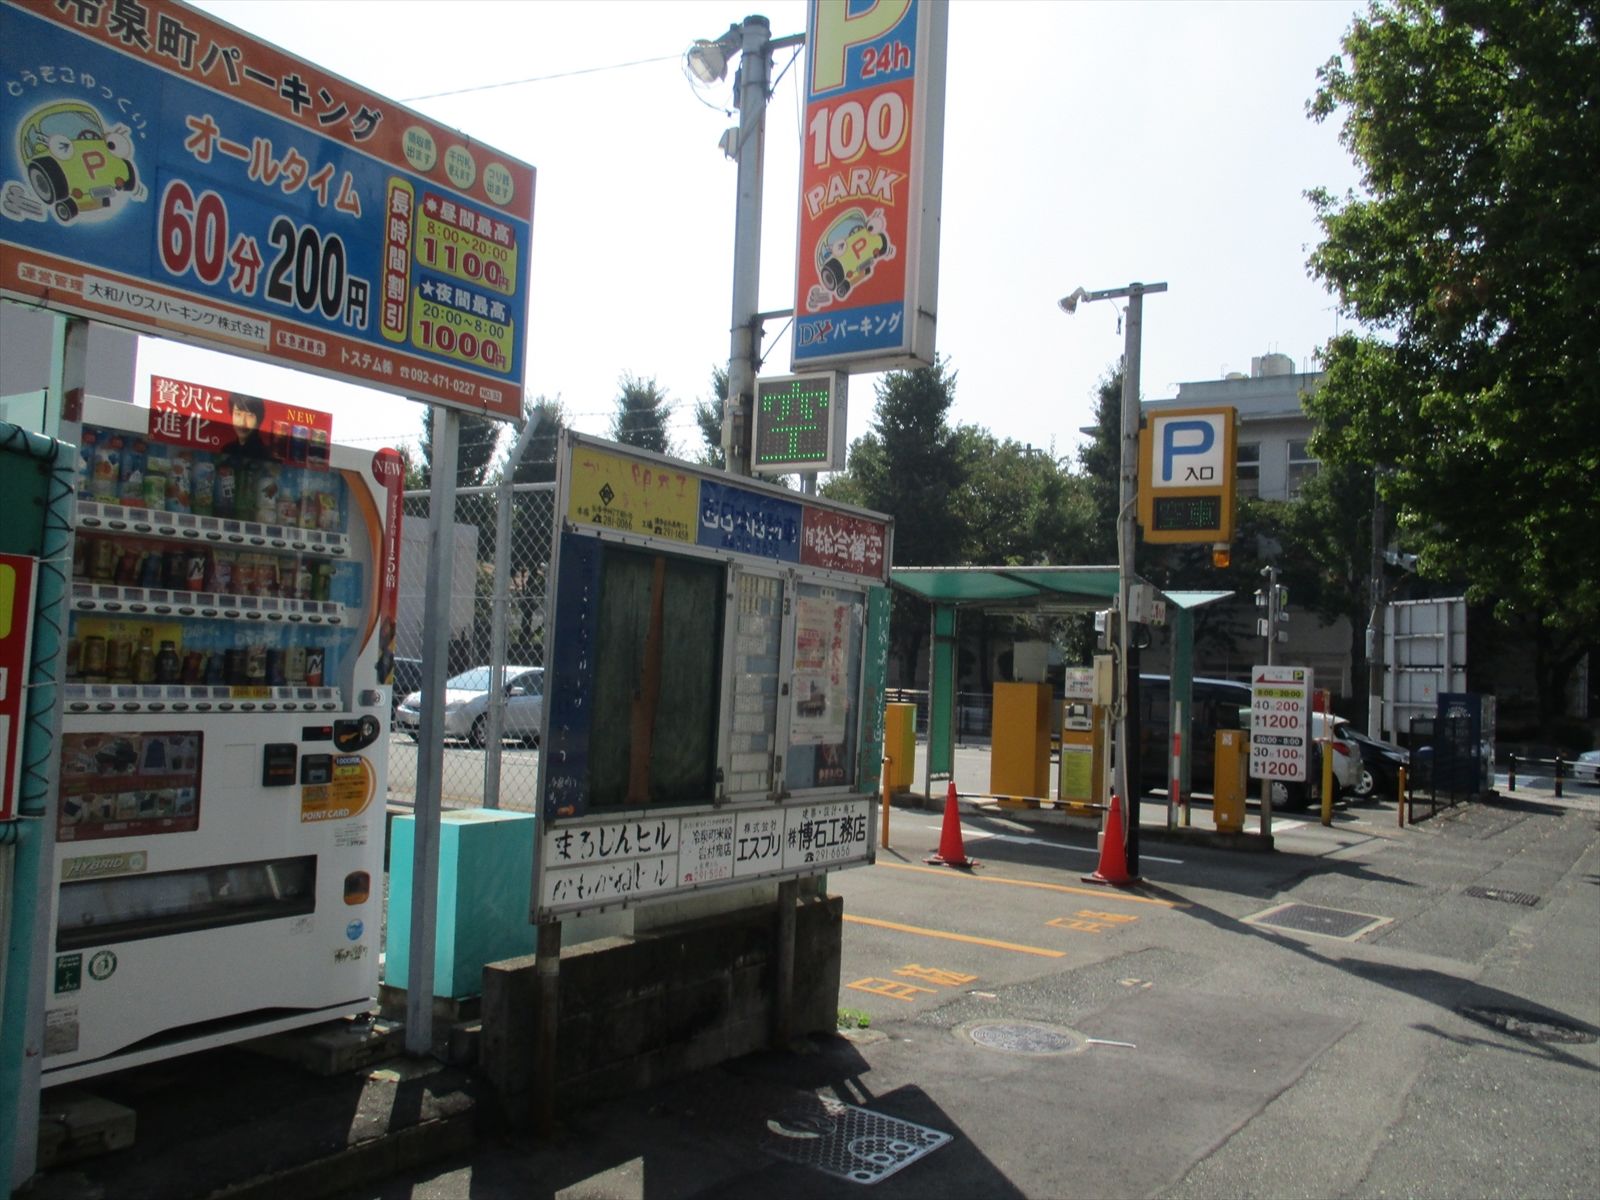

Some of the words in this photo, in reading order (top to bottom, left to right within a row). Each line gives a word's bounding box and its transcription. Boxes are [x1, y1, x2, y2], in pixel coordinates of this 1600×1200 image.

[860, 41, 910, 80] 24h
[808, 92, 908, 168] 100
[184, 115, 362, 218] オールタイム
[805, 166, 908, 220] PARK
[439, 202, 510, 245] 昼間最高
[19, 263, 83, 292] 運営管理
[384, 187, 409, 332] 長時間割引
[424, 237, 509, 291] 1100円
[88, 282, 266, 339] 大和ハウスパーキング株式会社
[436, 281, 506, 323] 夜間最高
[420, 320, 506, 370] 1000円
[156, 379, 224, 414] 贅沢に
[411, 369, 476, 396] 092-471-0227
[153, 406, 220, 446] 進化。
[287, 408, 316, 425] NEW
[761, 382, 829, 461] 空
[374, 460, 402, 477] NEW
[1162, 420, 1215, 482] P
[1185, 466, 1214, 481] 入口
[302, 811, 327, 821] POINT
[328, 808, 350, 818] CARD
[736, 832, 781, 862] エスプリ
